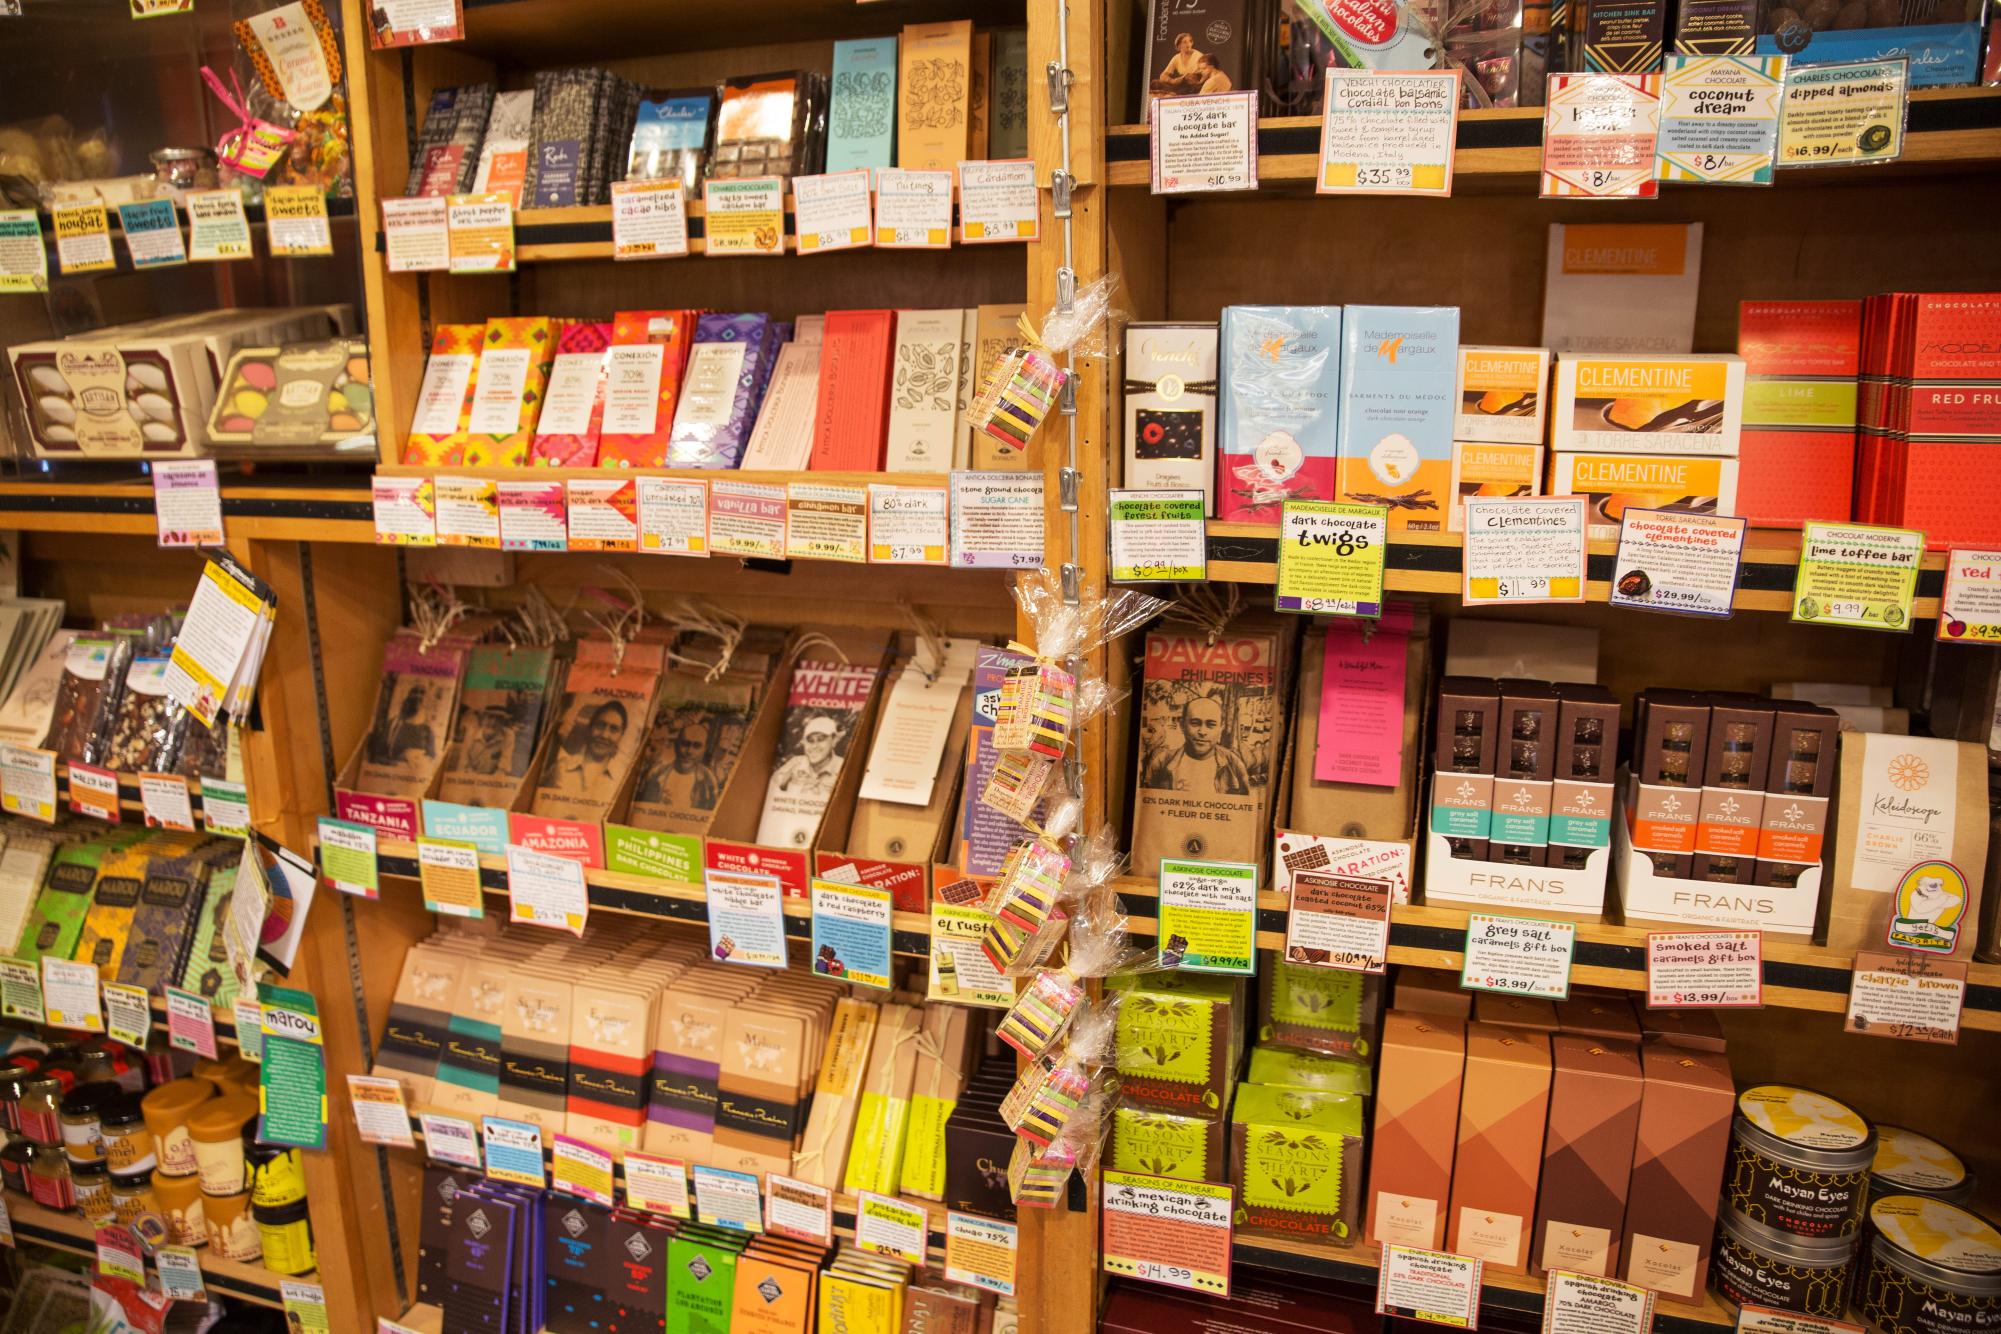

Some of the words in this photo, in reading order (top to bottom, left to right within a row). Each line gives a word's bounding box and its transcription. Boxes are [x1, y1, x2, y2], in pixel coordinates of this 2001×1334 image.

[1624, 9, 1640, 17] SINK
[1340, 88, 1396, 100] chocolate
[1400, 87, 1447, 99] balsamic
[1689, 89, 1754, 102] coconut
[1791, 86, 1834, 100] dipped
[1839, 82, 1893, 96] almonds
[1394, 99, 1411, 109] bon
[1414, 99, 1443, 109] bons
[1694, 102, 1746, 115] dream
[1207, 112, 1227, 120] dark
[1173, 122, 1218, 133] chocolate
[1221, 121, 1237, 129] bar
[271, 204, 320, 216] sweets
[60, 217, 102, 230] nougat
[128, 218, 171, 230] sweets
[1364, 330, 1438, 341] Mademoiselle
[1466, 358, 1538, 374] CLEMENTINE
[1579, 367, 1693, 388] CLEMENTINE
[1780, 387, 1815, 398] LIME
[1932, 394, 1965, 404] RED
[1461, 451, 1534, 466] CLEMENTINE
[1576, 461, 1688, 483] CLEMENTINE
[985, 486, 1011, 495] ground
[717, 500, 757, 513] vanilla
[761, 503, 781, 514] bar
[798, 501, 838, 512] cinnamon
[841, 502, 858, 513] bar
[1114, 502, 1161, 512] chocolate
[1164, 501, 1201, 510] covered
[1290, 504, 1337, 513] MADEMOISELLE
[1347, 507, 1380, 515] MARGAUX
[1535, 505, 1577, 514] covered
[1124, 510, 1158, 520] forest
[1161, 510, 1191, 519] fruits
[1291, 515, 1317, 525] dark
[1321, 518, 1377, 530] chocolate
[1630, 522, 1688, 535] chocolate
[1692, 527, 1737, 539] covered
[1827, 532, 1864, 540] CHOCOLAT
[1866, 534, 1901, 543] MODERNE
[1298, 530, 1369, 556] twigs
[1645, 532, 1718, 546] clementines
[1811, 545, 1836, 556] lime
[1841, 547, 1887, 560] toffee
[1892, 552, 1913, 562] bar
[1962, 567, 1991, 579] red
[1145, 638, 1260, 665] DAVAO
[792, 670, 875, 696] WHITE
[1181, 669, 1264, 683] PHILIPPINES
[1158, 798, 1181, 806] DARK
[1183, 800, 1201, 808] MILK
[1204, 801, 1253, 812] CHOCOLATE
[1872, 793, 1941, 824] Kaleidoscope
[346, 807, 410, 830] TANZANIA
[1167, 810, 1197, 819] FLEUR
[1200, 812, 1213, 820] DE
[1214, 813, 1231, 821] SEL
[435, 825, 497, 836] ECUADOR
[521, 838, 589, 849] AMAZONIA
[617, 839, 690, 870] PHILIPPINES
[717, 853, 746, 864] WHITE
[1207, 868, 1243, 877] CHOCOLATE
[1172, 882, 1195, 890] 62%
[1198, 883, 1219, 891] dark
[1220, 885, 1241, 894] milk
[1304, 877, 1337, 886] ASKINOSIE
[1339, 881, 1379, 892] CHOCOLATE
[1470, 873, 1565, 895] FRAN'S
[821, 893, 838, 901] dark
[1164, 889, 1198, 897] chocolate
[1310, 888, 1329, 896] dark
[1331, 891, 1372, 902] chocolate
[1296, 896, 1329, 905] toasted
[1332, 899, 1364, 909] coconut
[1365, 904, 1386, 913] 65%
[1673, 892, 1776, 914] FRAN'S
[1485, 924, 1518, 938] grey
[1522, 928, 1552, 941] salt
[1893, 933, 1949, 946] FAVORITE
[1472, 936, 1520, 950] caramels
[1523, 940, 1548, 953] gift
[1551, 945, 1568, 954] box
[1656, 941, 1713, 952] smoked
[1717, 940, 1748, 951] salt
[1653, 953, 1705, 964] caramels
[1708, 953, 1735, 965] gift
[1738, 953, 1756, 961] box
[1919, 979, 1959, 991] brown
[264, 1009, 316, 1034] marou
[1126, 1010, 1200, 1032] SEASONS
[1136, 1029, 1190, 1043] HEART
[1122, 1084, 1201, 1106] CHOCOLATE
[1257, 1145, 1331, 1164] SEASONS
[1122, 1176, 1160, 1186] SEASONS
[1163, 1180, 1173, 1188] OF
[1190, 1184, 1216, 1194] HEART
[1768, 1176, 1815, 1200] Mayan
[1818, 1186, 1849, 1200] Eyes
[1138, 1192, 1192, 1206] mexican
[1107, 1197, 1159, 1214] drinking
[1163, 1204, 1227, 1223] chocolate
[1249, 1215, 1329, 1235] CHOCOLATE
[986, 1231, 1009, 1244] 75%
[1719, 1246, 1755, 1275] Mayan
[1756, 1270, 1791, 1290] Eyes
[1565, 1281, 1598, 1290] spanish
[1600, 1286, 1637, 1302] drinking
[1577, 1289, 1623, 1302] chocolate
[1594, 1306, 1635, 1319] CHOCOLATE
